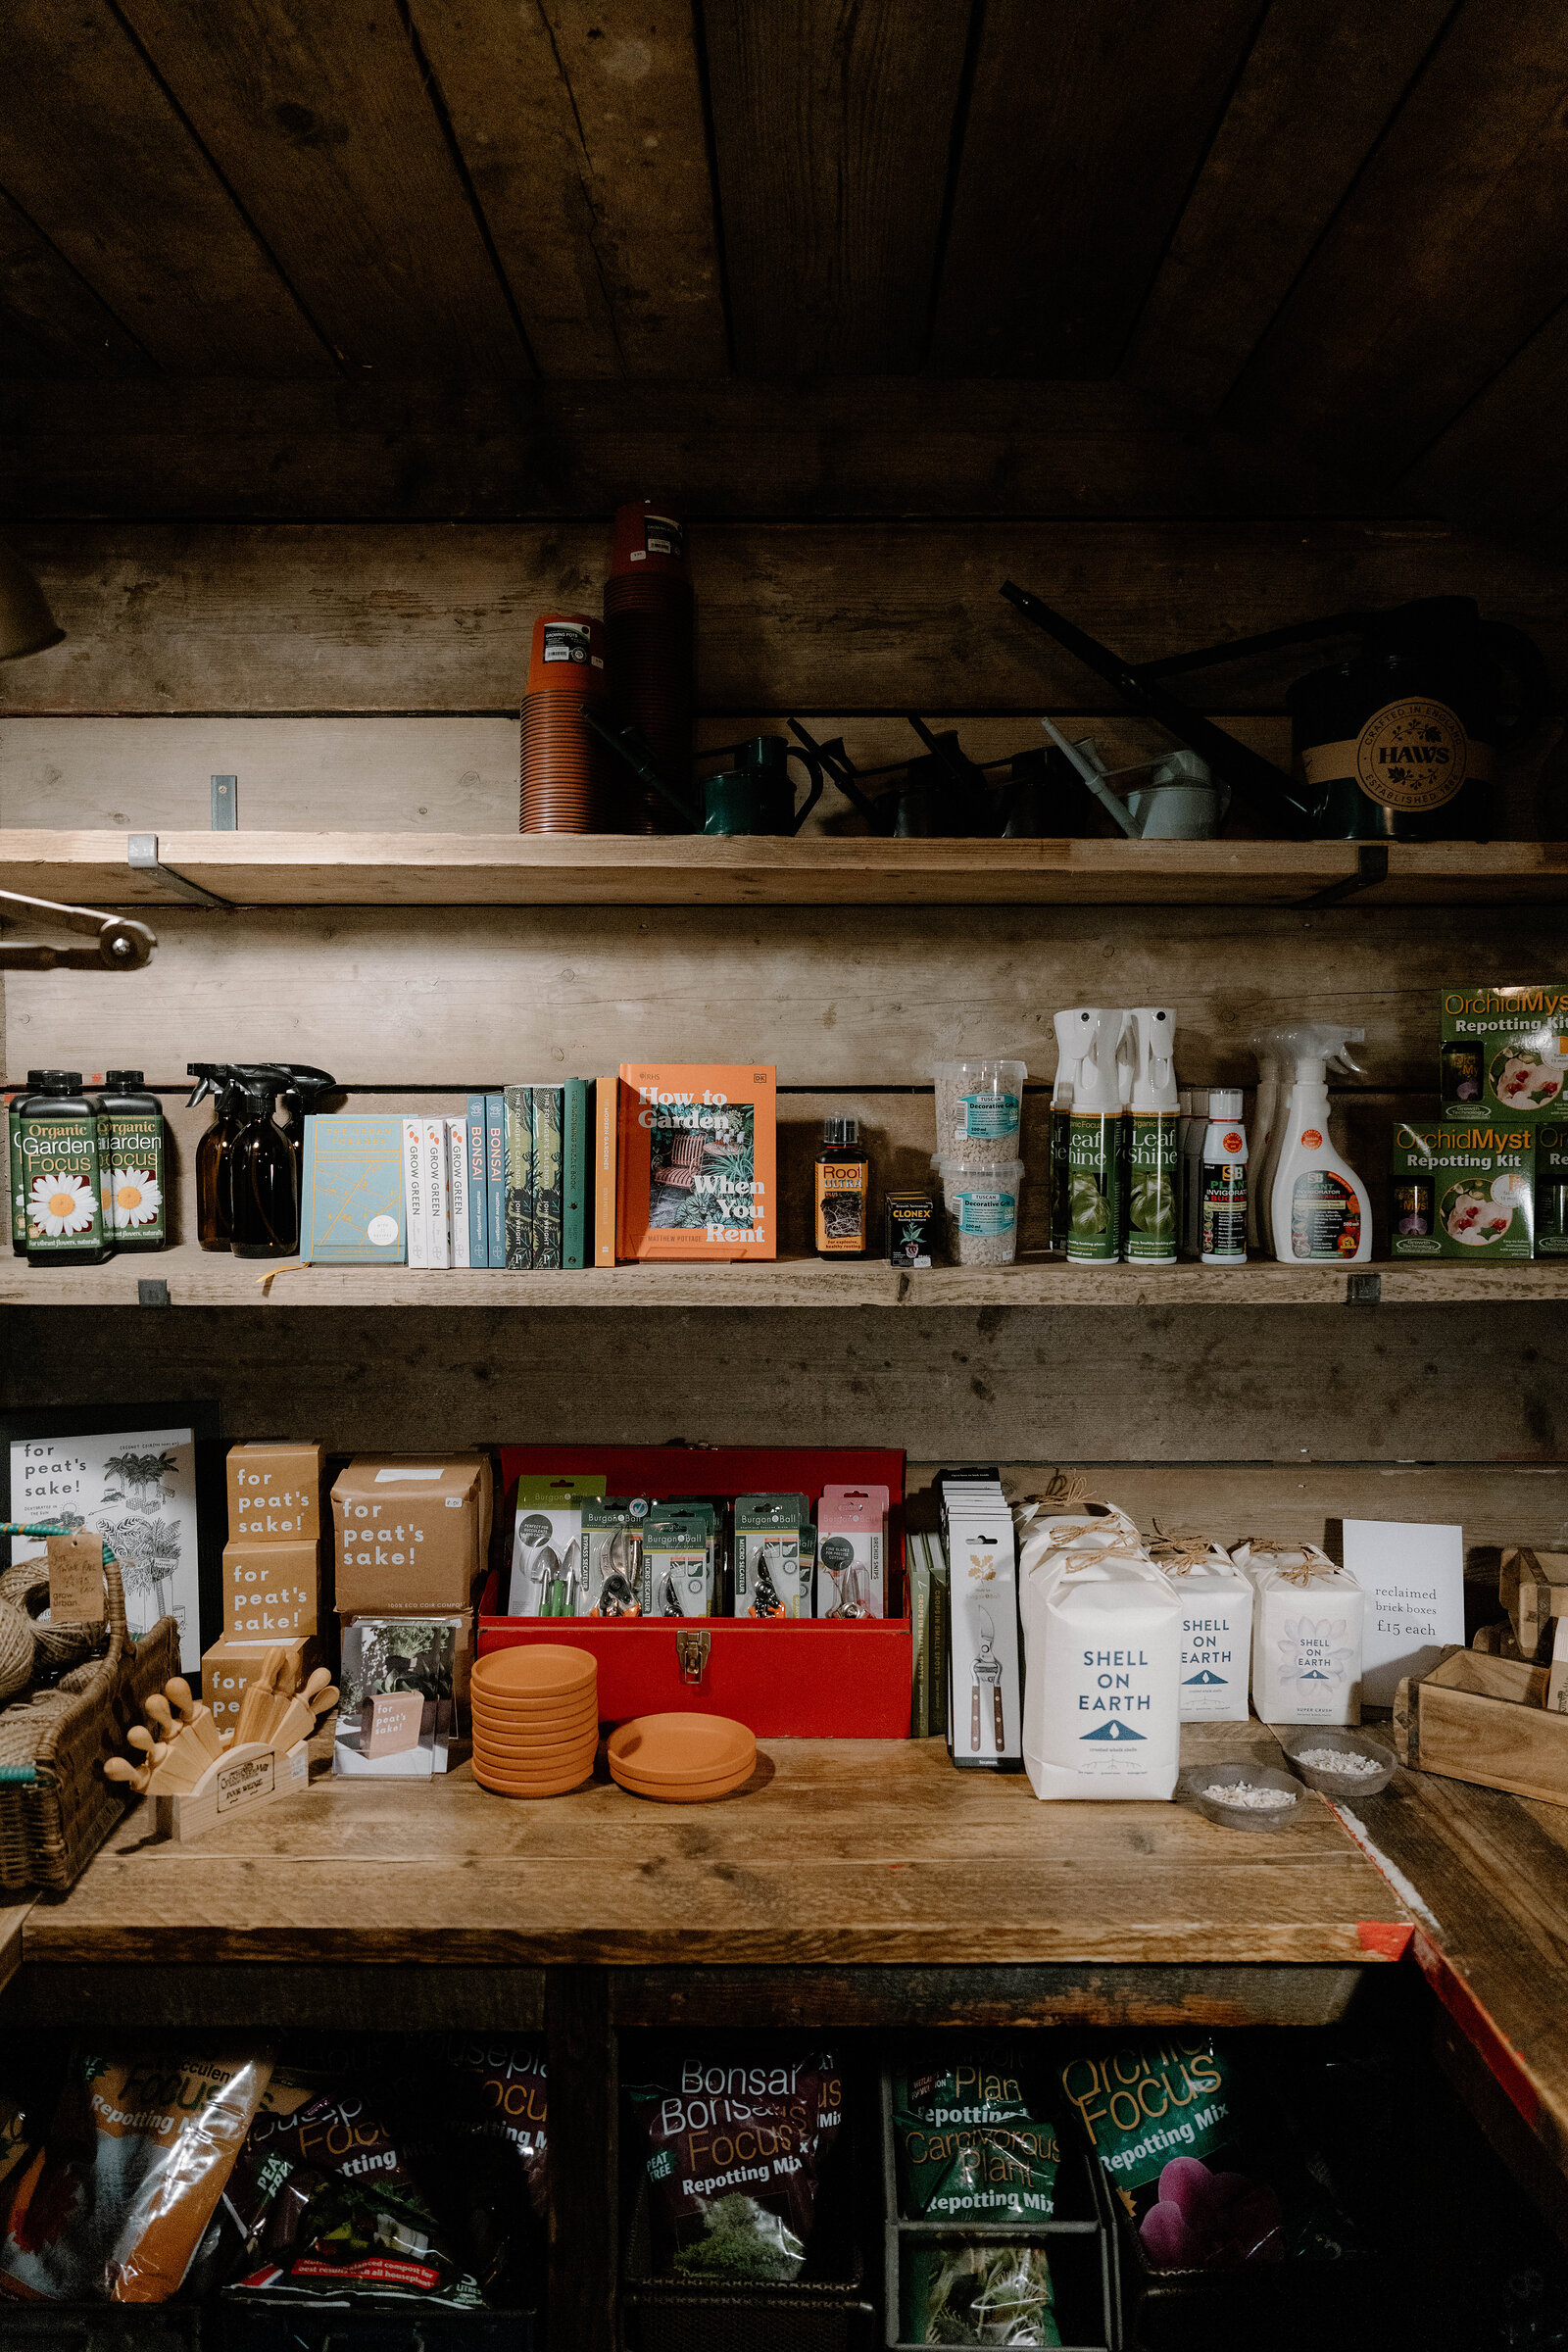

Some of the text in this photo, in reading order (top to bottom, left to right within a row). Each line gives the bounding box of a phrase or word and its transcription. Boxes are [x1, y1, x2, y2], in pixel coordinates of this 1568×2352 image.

[1364, 708, 1462, 745] CRAFTED ENGLAND
[1379, 746, 1450, 764] HAWS
[1365, 774, 1437, 804] ESTABLISHED
[1445, 992, 1568, 1016] OrchidMys
[1456, 1017, 1542, 1035] Repotting
[638, 1087, 727, 1105] How to
[639, 1110, 730, 1129] Garden
[29, 1124, 87, 1140] Organic
[1133, 1129, 1176, 1147] Leaf
[1397, 1129, 1531, 1153] OrchidMyst
[24, 1137, 94, 1154] Garden
[110, 1133, 162, 1150] arden
[112, 1152, 157, 1166] ocus
[471, 1126, 483, 1181] BONSAI
[490, 1127, 502, 1182] BONSAI
[1128, 1147, 1178, 1164] Shine
[1407, 1154, 1521, 1170] Repotting Kit
[27, 1154, 91, 1172] Focus
[823, 1166, 862, 1178] Root
[410, 1147, 420, 1215] GROW GREEN
[429, 1147, 440, 1217] GROW GREEN
[453, 1146, 463, 1214] GROW GREEN
[1223, 1166, 1243, 1181] SB
[694, 1176, 764, 1194] When
[824, 1179, 862, 1188] ULTRA
[716, 1200, 764, 1218] You
[893, 1209, 931, 1218] CLONEX
[706, 1223, 764, 1243] Rent
[24, 1444, 54, 1457] for
[25, 1458, 86, 1480] peat's
[237, 1469, 272, 1486] for
[25, 1480, 80, 1496] sake!
[238, 1492, 310, 1513] peat's
[343, 1498, 382, 1518] for
[238, 1515, 302, 1533] sake!
[588, 1513, 616, 1522] Burgon
[742, 1516, 772, 1525] Burgon
[344, 1524, 424, 1548] peat's
[647, 1534, 702, 1544] Burgon Ball
[343, 1545, 416, 1566] sake!
[234, 1566, 270, 1583] for
[235, 1588, 307, 1611] peat's
[1375, 1587, 1437, 1600] reclaimed
[1376, 1602, 1437, 1615] brick boxes
[235, 1611, 299, 1631] sake!
[918, 1619, 923, 1628] IN
[935, 1615, 941, 1624] IN
[1183, 1620, 1230, 1631] SHELL
[1377, 1620, 1436, 1637] £15 each
[1193, 1637, 1216, 1647] ON
[1300, 1639, 1329, 1647] SHELL
[1084, 1650, 1149, 1666] SHELL
[1181, 1651, 1232, 1663] EARTH
[213, 1671, 247, 1689] for
[1098, 1673, 1129, 1689] ON
[377, 1705, 392, 1714] for
[1078, 1695, 1151, 1711] EARTH
[376, 1713, 407, 1725] peat's
[375, 1724, 403, 1736] sake!
[681, 2058, 798, 2095] Bonsai
[956, 2065, 1023, 2101] Plan
[1078, 2054, 1221, 2145] Focus
[92, 2093, 174, 2134] Repotting
[1100, 2103, 1230, 2172] Repotting Mix
[687, 2125, 792, 2172] Focus
[906, 2129, 1061, 2165] Carnivorous
[647, 2151, 668, 2172] PEAT
[960, 2150, 1034, 2188] Plant
[682, 2156, 803, 2195] Repotting Mix
[927, 2189, 1054, 2214] Repotting Mix
[384, 2261, 433, 2278] compost for
